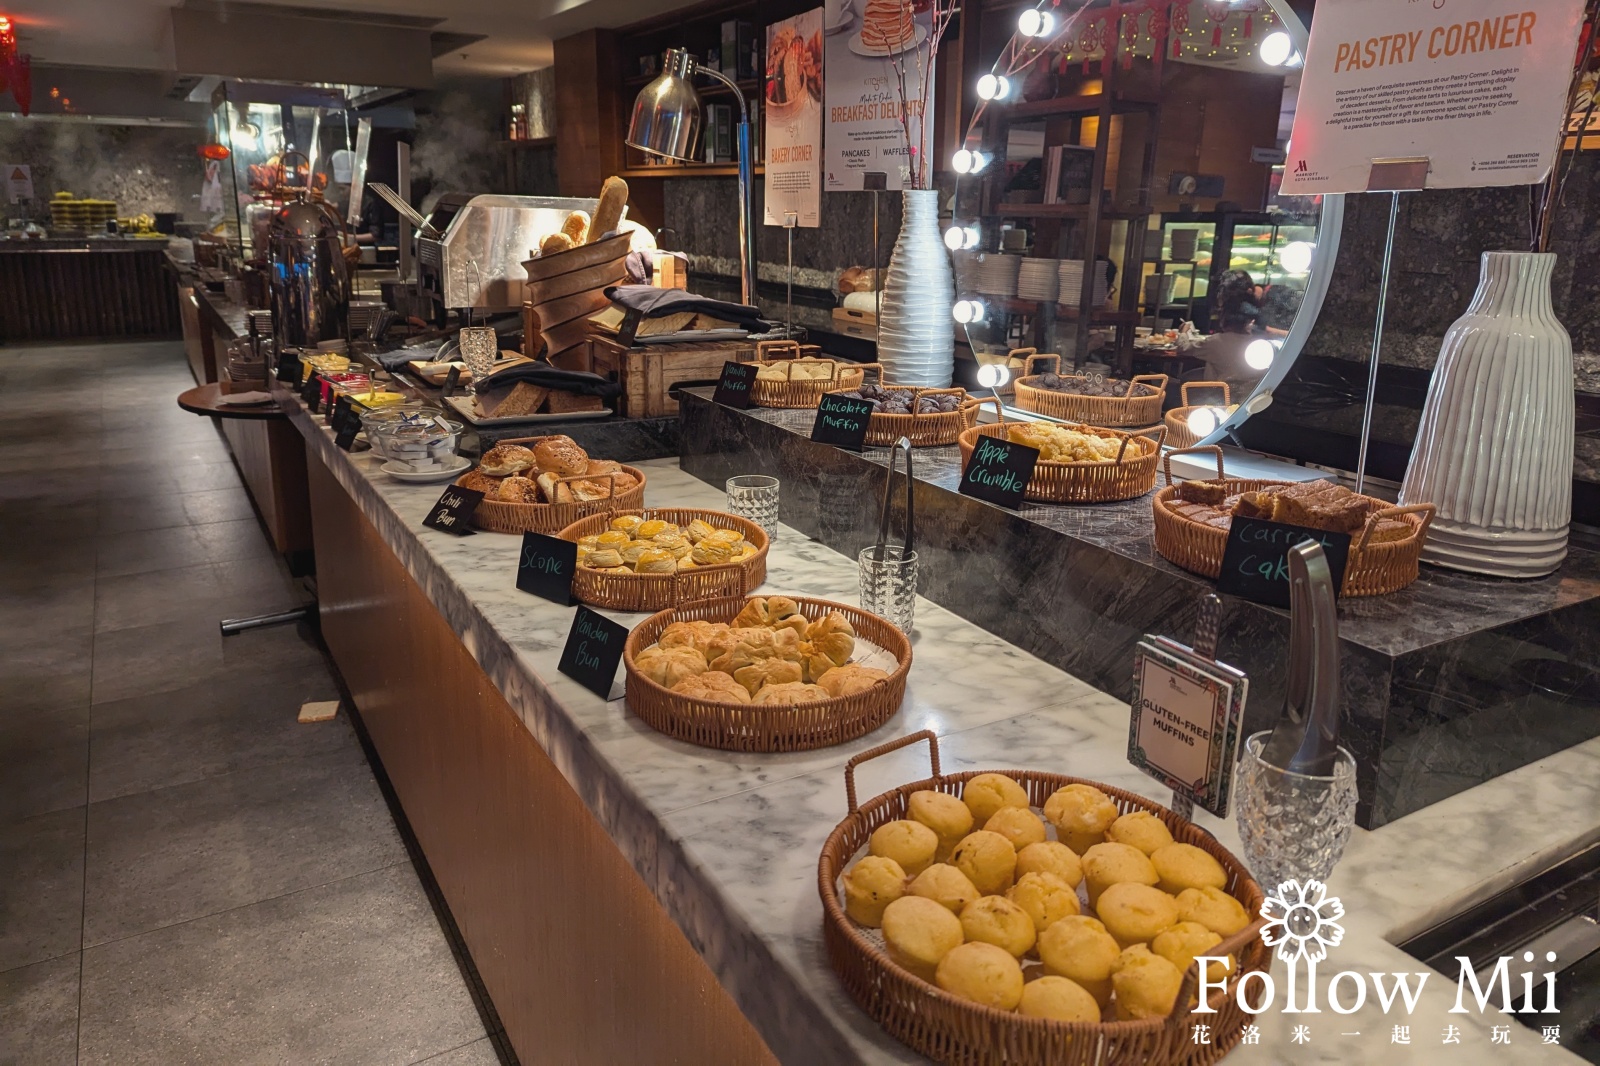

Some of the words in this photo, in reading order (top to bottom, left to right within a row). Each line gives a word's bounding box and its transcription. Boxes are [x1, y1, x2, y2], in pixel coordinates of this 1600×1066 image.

[1334, 30, 1423, 73] PASTRY
[1428, 12, 1536, 58] CORNER
[1468, 78, 1494, 86] tempting
[860, 94, 872, 103] Made
[880, 92, 892, 103] Order
[832, 104, 878, 123] BREAKFAST
[772, 147, 790, 163] BAKERY
[792, 145, 812, 161] CORNER
[883, 148, 909, 156] WAFFLES
[820, 398, 868, 414] Chocolate
[976, 440, 1008, 465] Apple
[970, 465, 1023, 492] Crumble
[436, 509, 456, 526] Bun
[521, 545, 562, 574] Scone
[1239, 554, 1290, 580] Cak
[575, 641, 600, 670] Bun
[1143, 699, 1209, 741] GLUTEN-FREE
[1153, 717, 1194, 747] MUFFINS
